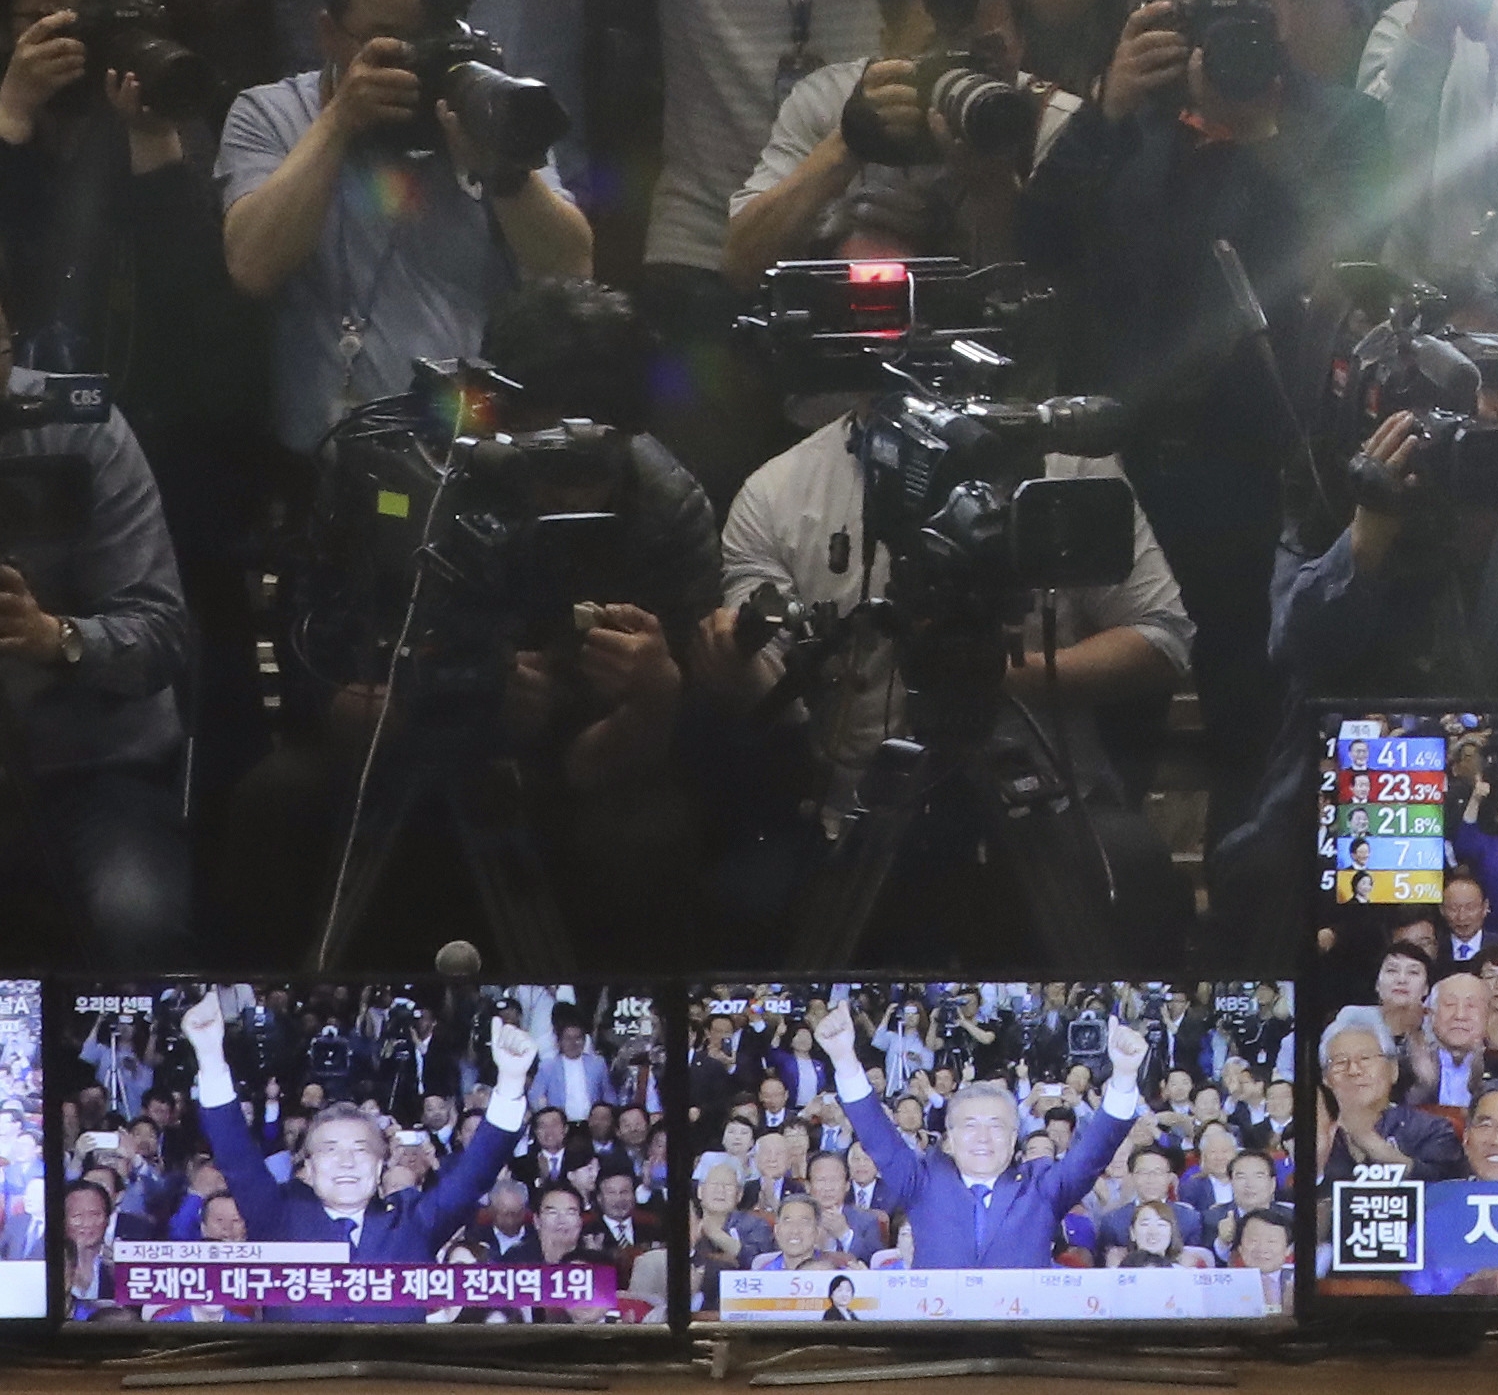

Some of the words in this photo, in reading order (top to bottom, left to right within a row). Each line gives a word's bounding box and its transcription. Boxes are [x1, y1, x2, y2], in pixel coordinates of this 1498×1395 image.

[70, 389, 102, 406] CBS
[1325, 737, 1337, 758] 1
[1377, 740, 1442, 768] 41.4%
[1320, 771, 1337, 792] 2
[1377, 774, 1442, 802] 23.3%
[1321, 805, 1336, 826] 3
[1377, 807, 1442, 835] 21.8%
[1320, 836, 1337, 858] 4
[1393, 840, 1442, 867] 7.1%
[1320, 870, 1337, 891] 5
[1393, 873, 1442, 900] 5.9%
[74, 996, 120, 1014] 우리의
[121, 996, 153, 1014] 선택
[708, 999, 748, 1014] 2017
[1352, 1163, 1407, 1187] 2017
[1349, 1194, 1408, 1220] 국민의
[133, 1244, 174, 1259] 지상파
[179, 1244, 201, 1259] 3사
[208, 1244, 262, 1260] 출구조사
[1345, 1219, 1408, 1259] 선택
[126, 1267, 214, 1302] 문재인,
[401, 1268, 455, 1301] 제외
[461, 1268, 542, 1302] 전지역
[550, 1268, 593, 1301] 1위
[733, 1277, 763, 1294] 전국
